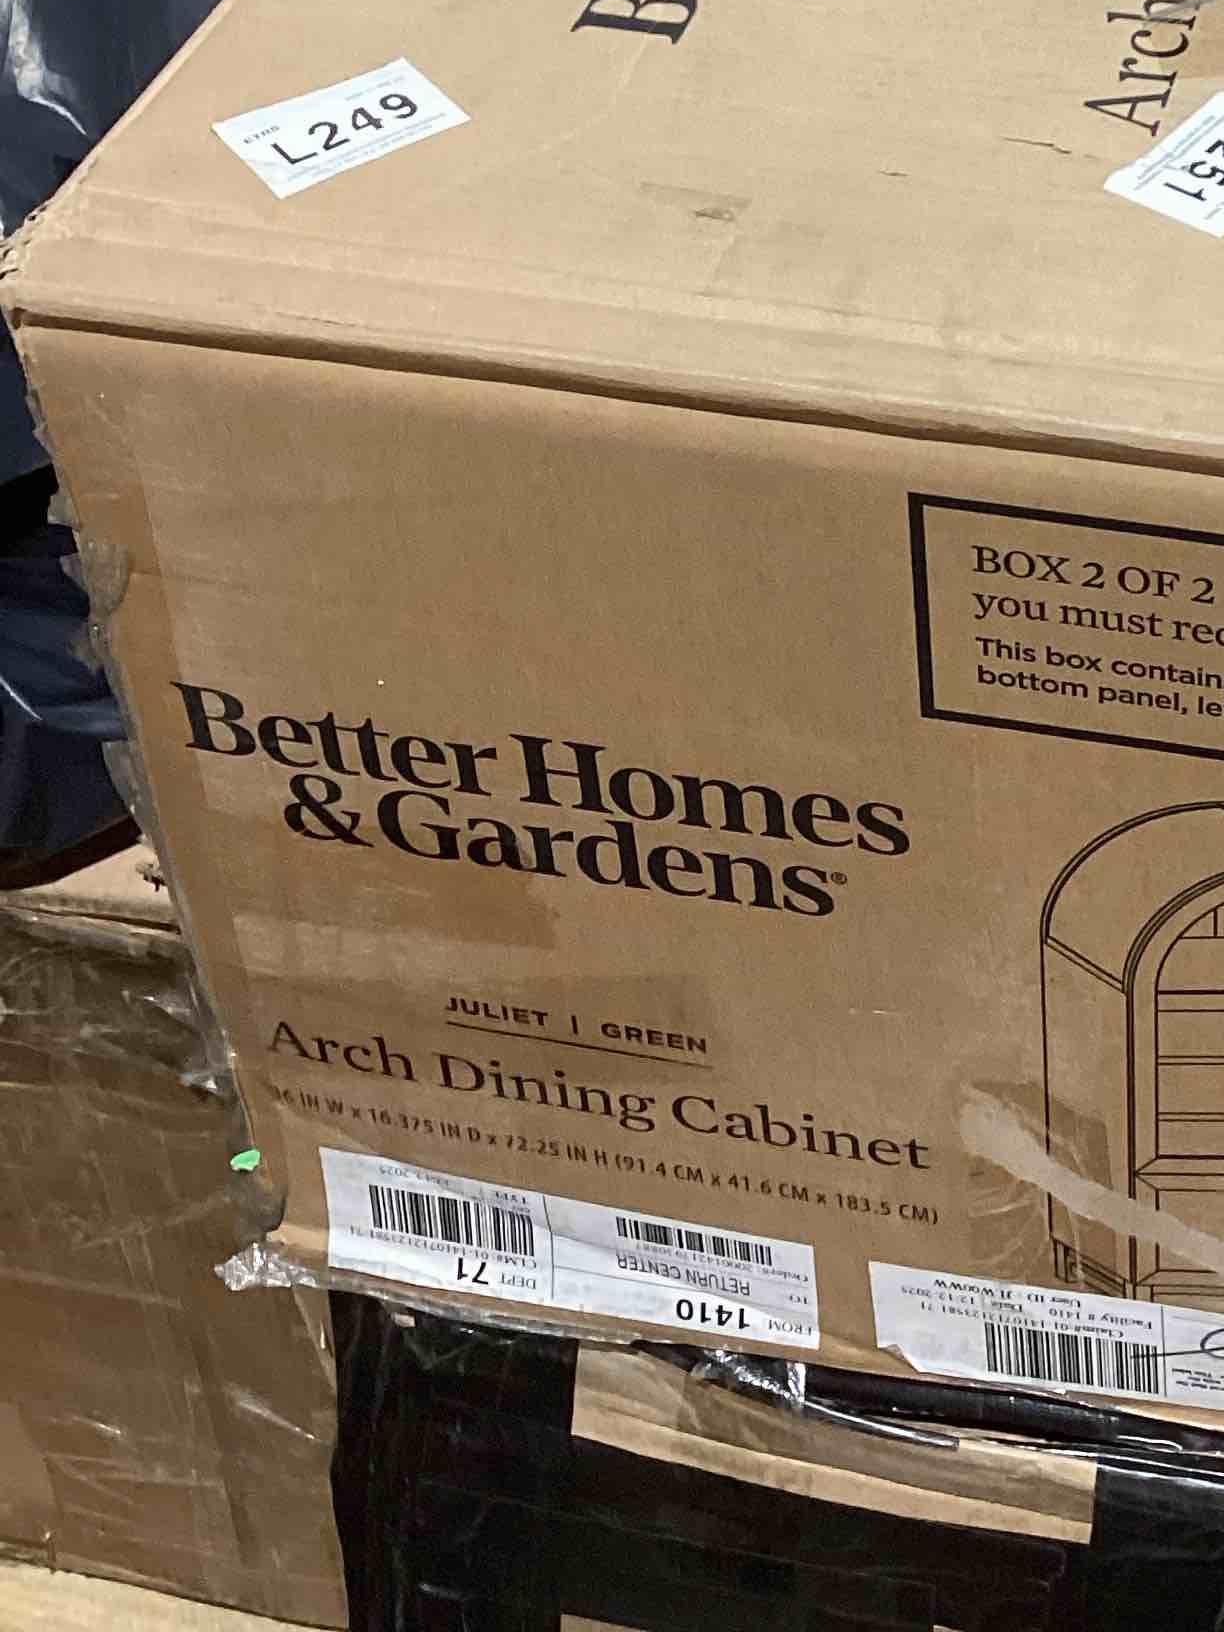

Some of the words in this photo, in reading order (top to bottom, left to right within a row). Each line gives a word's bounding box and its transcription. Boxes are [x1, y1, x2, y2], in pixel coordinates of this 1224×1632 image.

[271, 93, 418, 165] L249
[972, 546, 1070, 584] BOX
[1081, 563, 1105, 589] 2
[1117, 566, 1181, 598] OF
[1191, 577, 1216, 604] 2
[972, 591, 1049, 622] you
[1060, 605, 1163, 637] must
[976, 637, 1036, 663] This
[1046, 646, 1102, 672] box
[976, 665, 1088, 697] bottom
[1098, 684, 1188, 715] panel,
[170, 680, 497, 796] Better
[510, 733, 910, 856] Homes
[445, 996, 548, 1027] JULIET
[600, 1022, 707, 1054] GREEN
[268, 1020, 418, 1082] Arch
[438, 1053, 655, 1133] Dining
[672, 1095, 932, 1169] Cabinet
[324, 1097, 344, 1115] W
[438, 1120, 462, 1139] IN
[466, 1126, 481, 1141] D
[500, 1131, 561, 1157] 72.25
[564, 1143, 590, 1163] IN
[591, 1149, 609, 1167] H
[613, 1153, 667, 1178] (91.4
[671, 1163, 705, 1185] CM
[727, 1173, 773, 1196] 41.6
[777, 1182, 810, 1202] CM
[833, 1191, 892, 1218] 183.5
[898, 1202, 939, 1225] CM)
[455, 1256, 488, 1285] 71
[498, 1272, 535, 1289] DEPT
[615, 1253, 680, 1279] CENTER
[685, 1269, 749, 1295] RETURN
[675, 1297, 749, 1330] 1410
[1048, 1294, 1080, 1307] User
[1048, 1306, 1080, 1319] 1410
[768, 1318, 811, 1336] FROM
[1099, 1312, 1151, 1329] Facility
